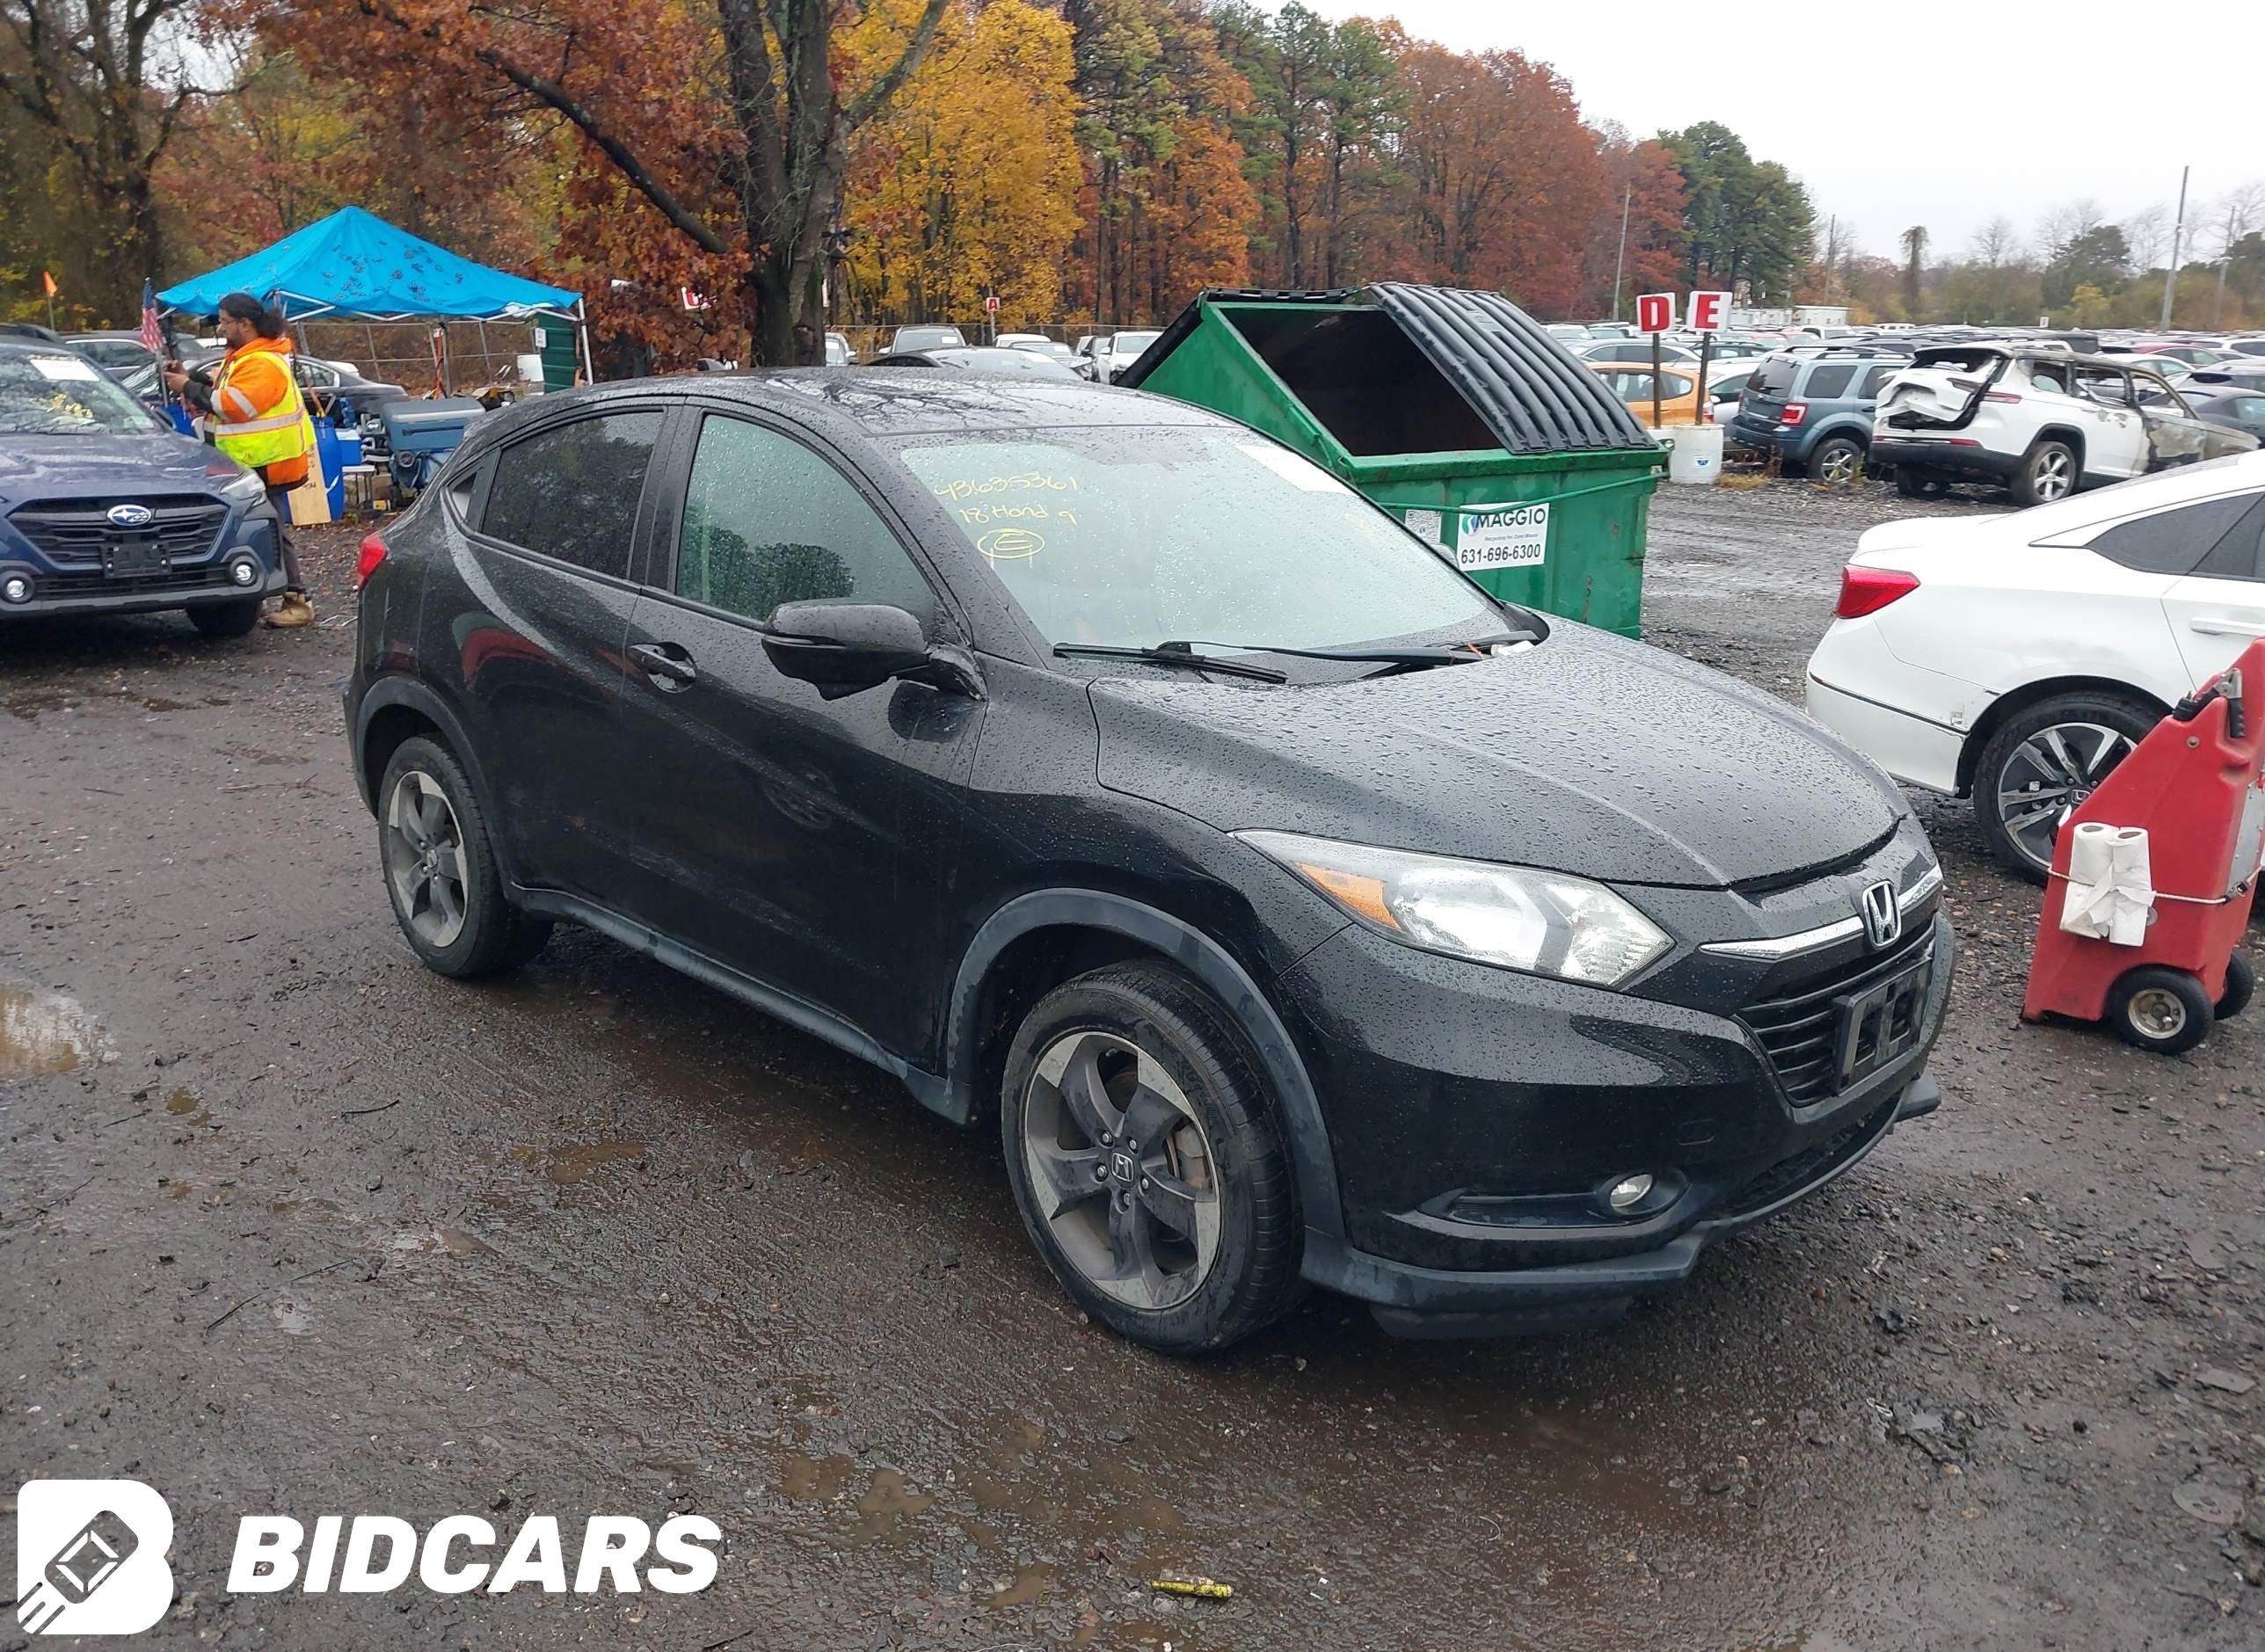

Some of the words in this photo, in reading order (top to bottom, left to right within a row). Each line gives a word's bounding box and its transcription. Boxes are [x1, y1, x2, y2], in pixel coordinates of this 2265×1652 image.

[988, 299, 999, 309] A
[1641, 296, 1670, 331] D
[1695, 295, 1720, 329] E
[959, 508, 989, 524] 18
[1477, 508, 1546, 528] MAGGIO
[1461, 543, 1540, 564] 631-696-6300
